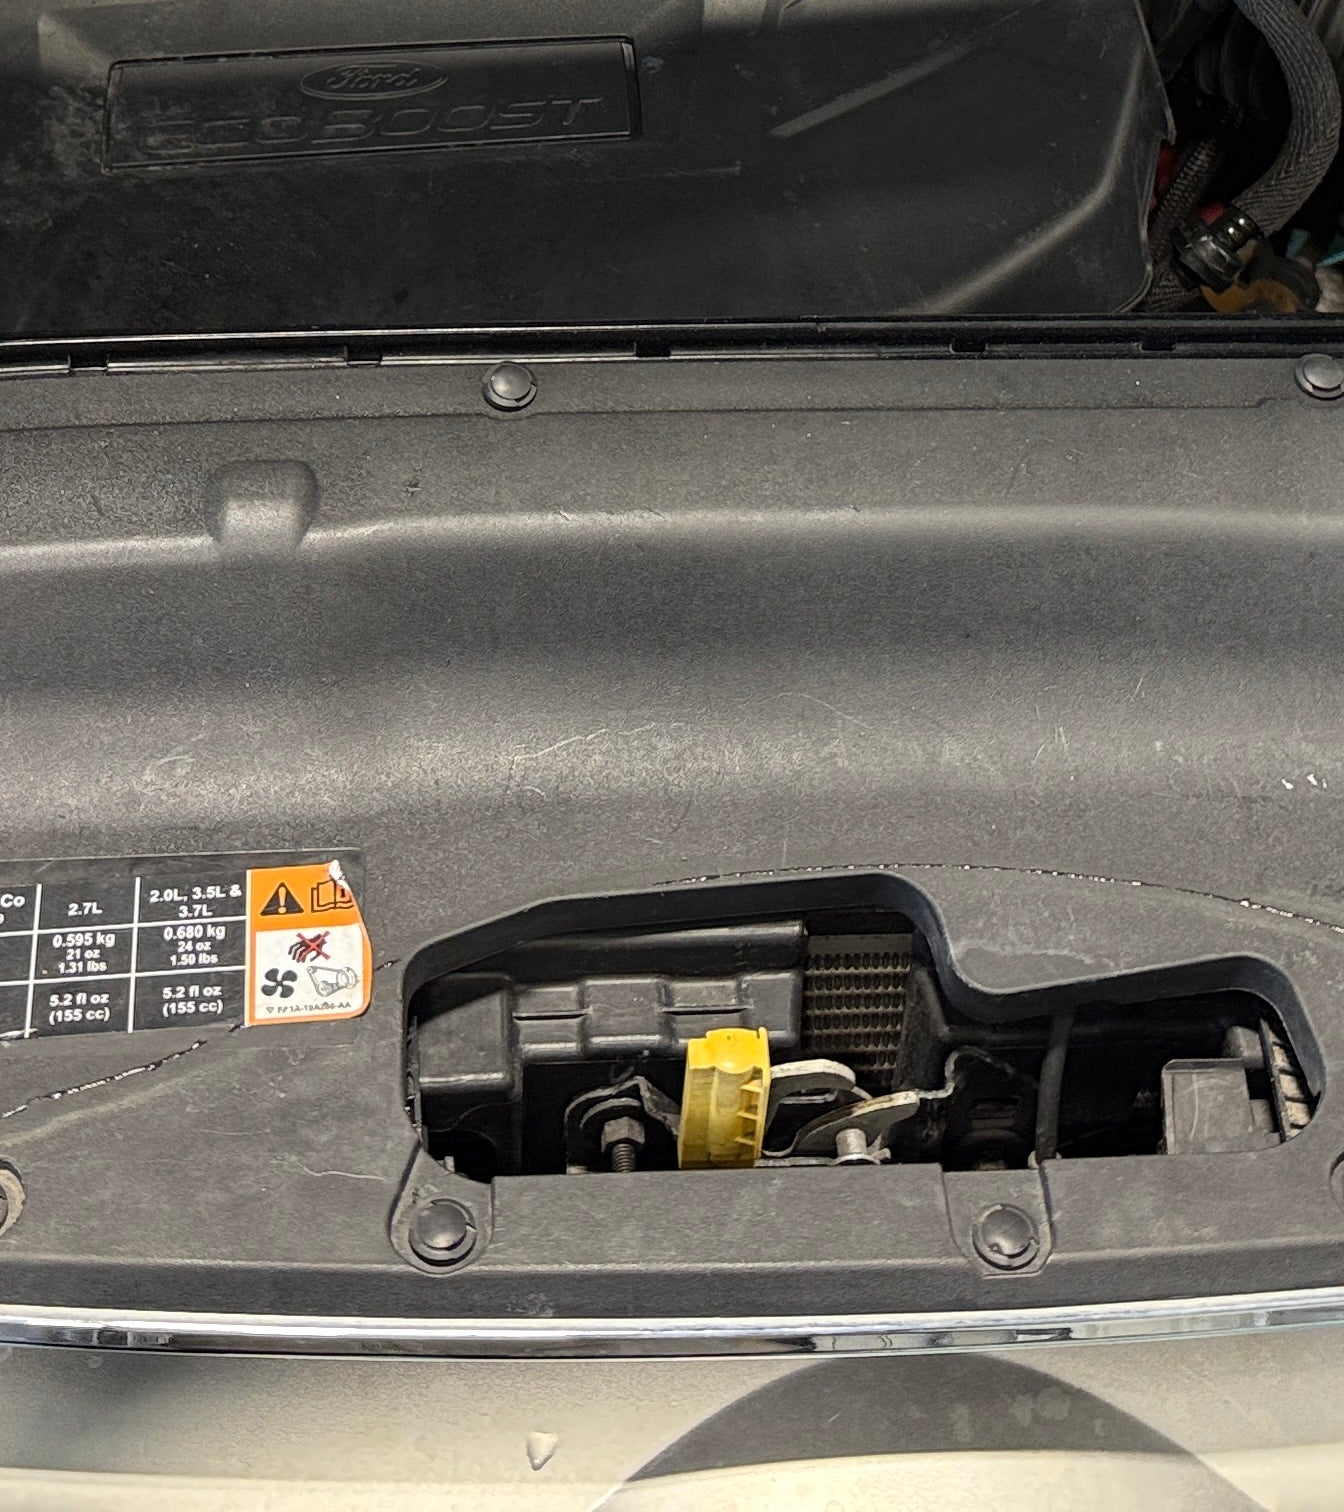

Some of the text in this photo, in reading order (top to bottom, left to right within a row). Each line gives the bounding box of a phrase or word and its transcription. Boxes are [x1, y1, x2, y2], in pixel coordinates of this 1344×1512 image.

[325, 61, 423, 89] Ford
[150, 885, 242, 903] 2.0L, 3.5L &
[68, 902, 103, 916] 2.7L
[178, 904, 213, 918] 3.7L
[163, 925, 226, 940] 0.680 kg
[53, 932, 115, 948] 0.595 kg
[177, 941, 211, 953] 24 oz
[66, 948, 100, 960] 21 oz
[170, 953, 218, 966] 1.50 lbs
[58, 960, 107, 974] 1.31 lbs
[162, 985, 222, 999] 5.2 fl oz
[49, 993, 110, 1007] 5.2 fl oz
[162, 1000, 223, 1017] (155 cc)
[49, 1007, 110, 1025] (155 cc)
